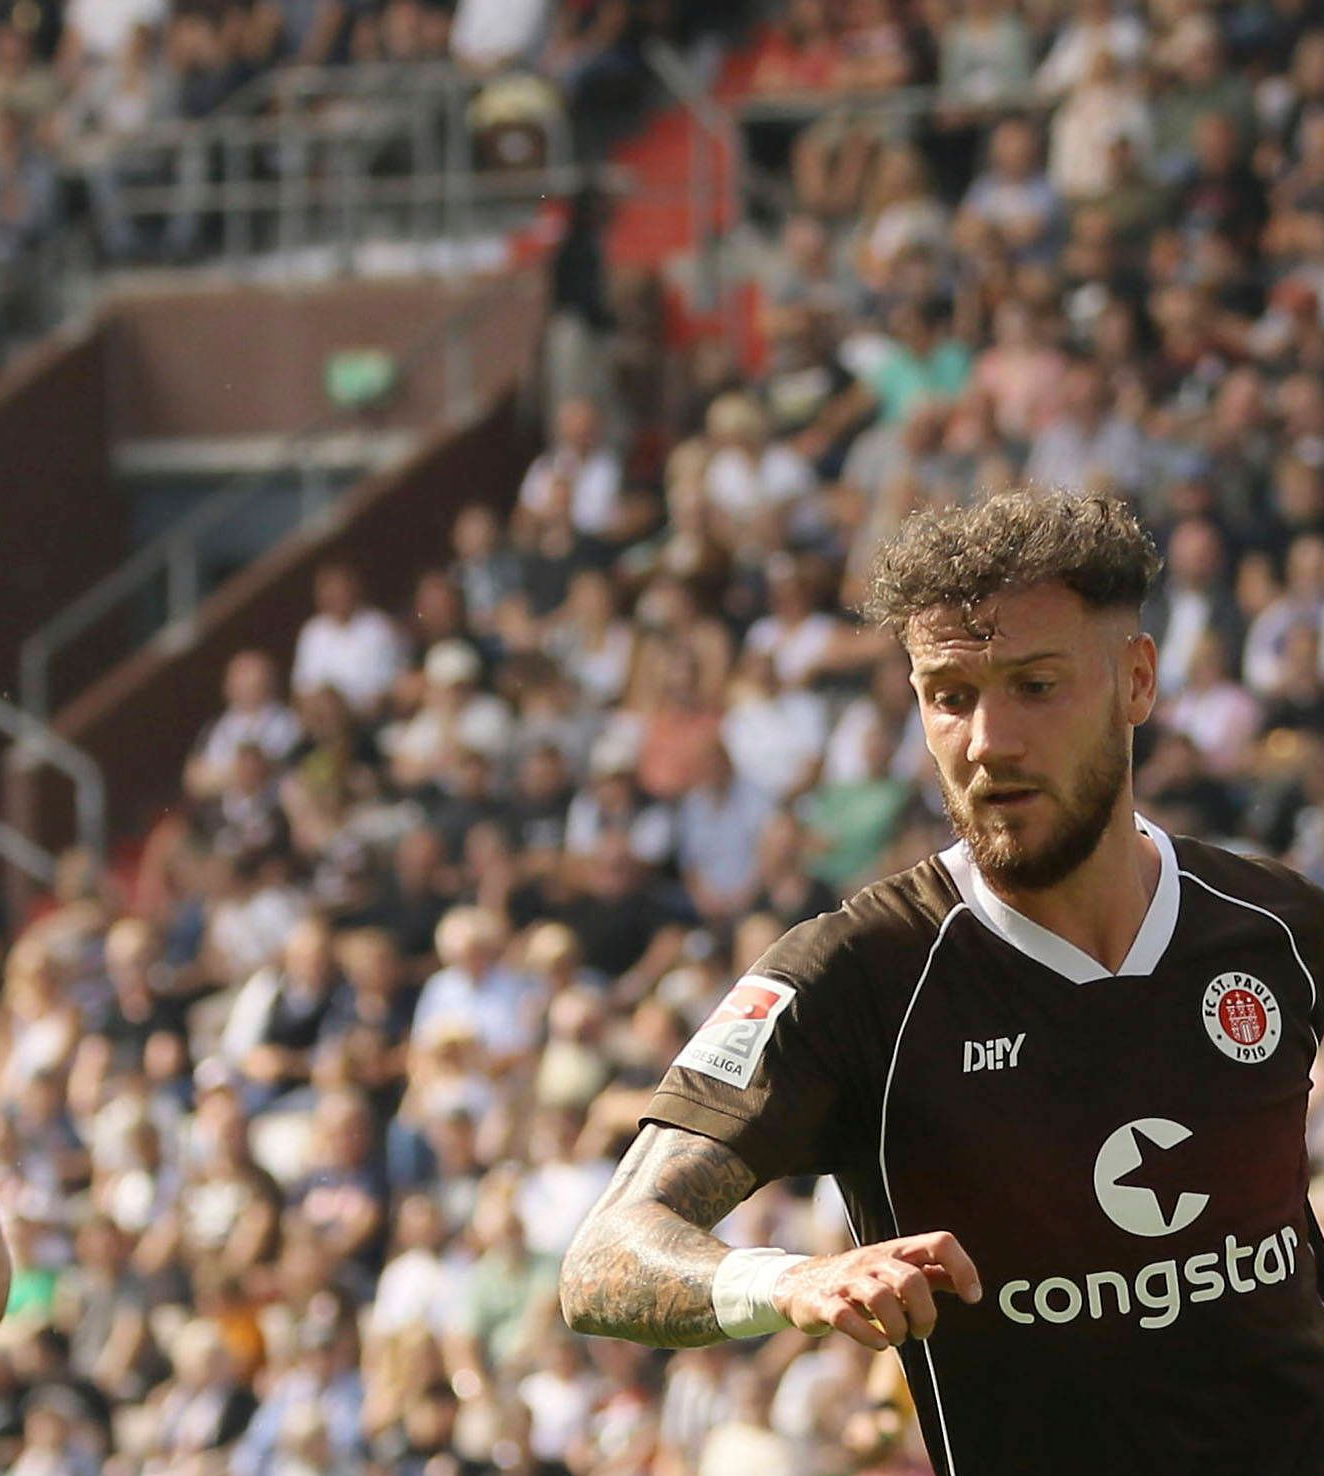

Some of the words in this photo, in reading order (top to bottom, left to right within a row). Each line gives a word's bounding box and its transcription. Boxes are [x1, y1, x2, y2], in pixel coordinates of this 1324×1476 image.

[1233, 975, 1276, 1012] PAULI
[1236, 1045, 1267, 1060] 1910
[998, 1225, 1298, 1329] congstar
